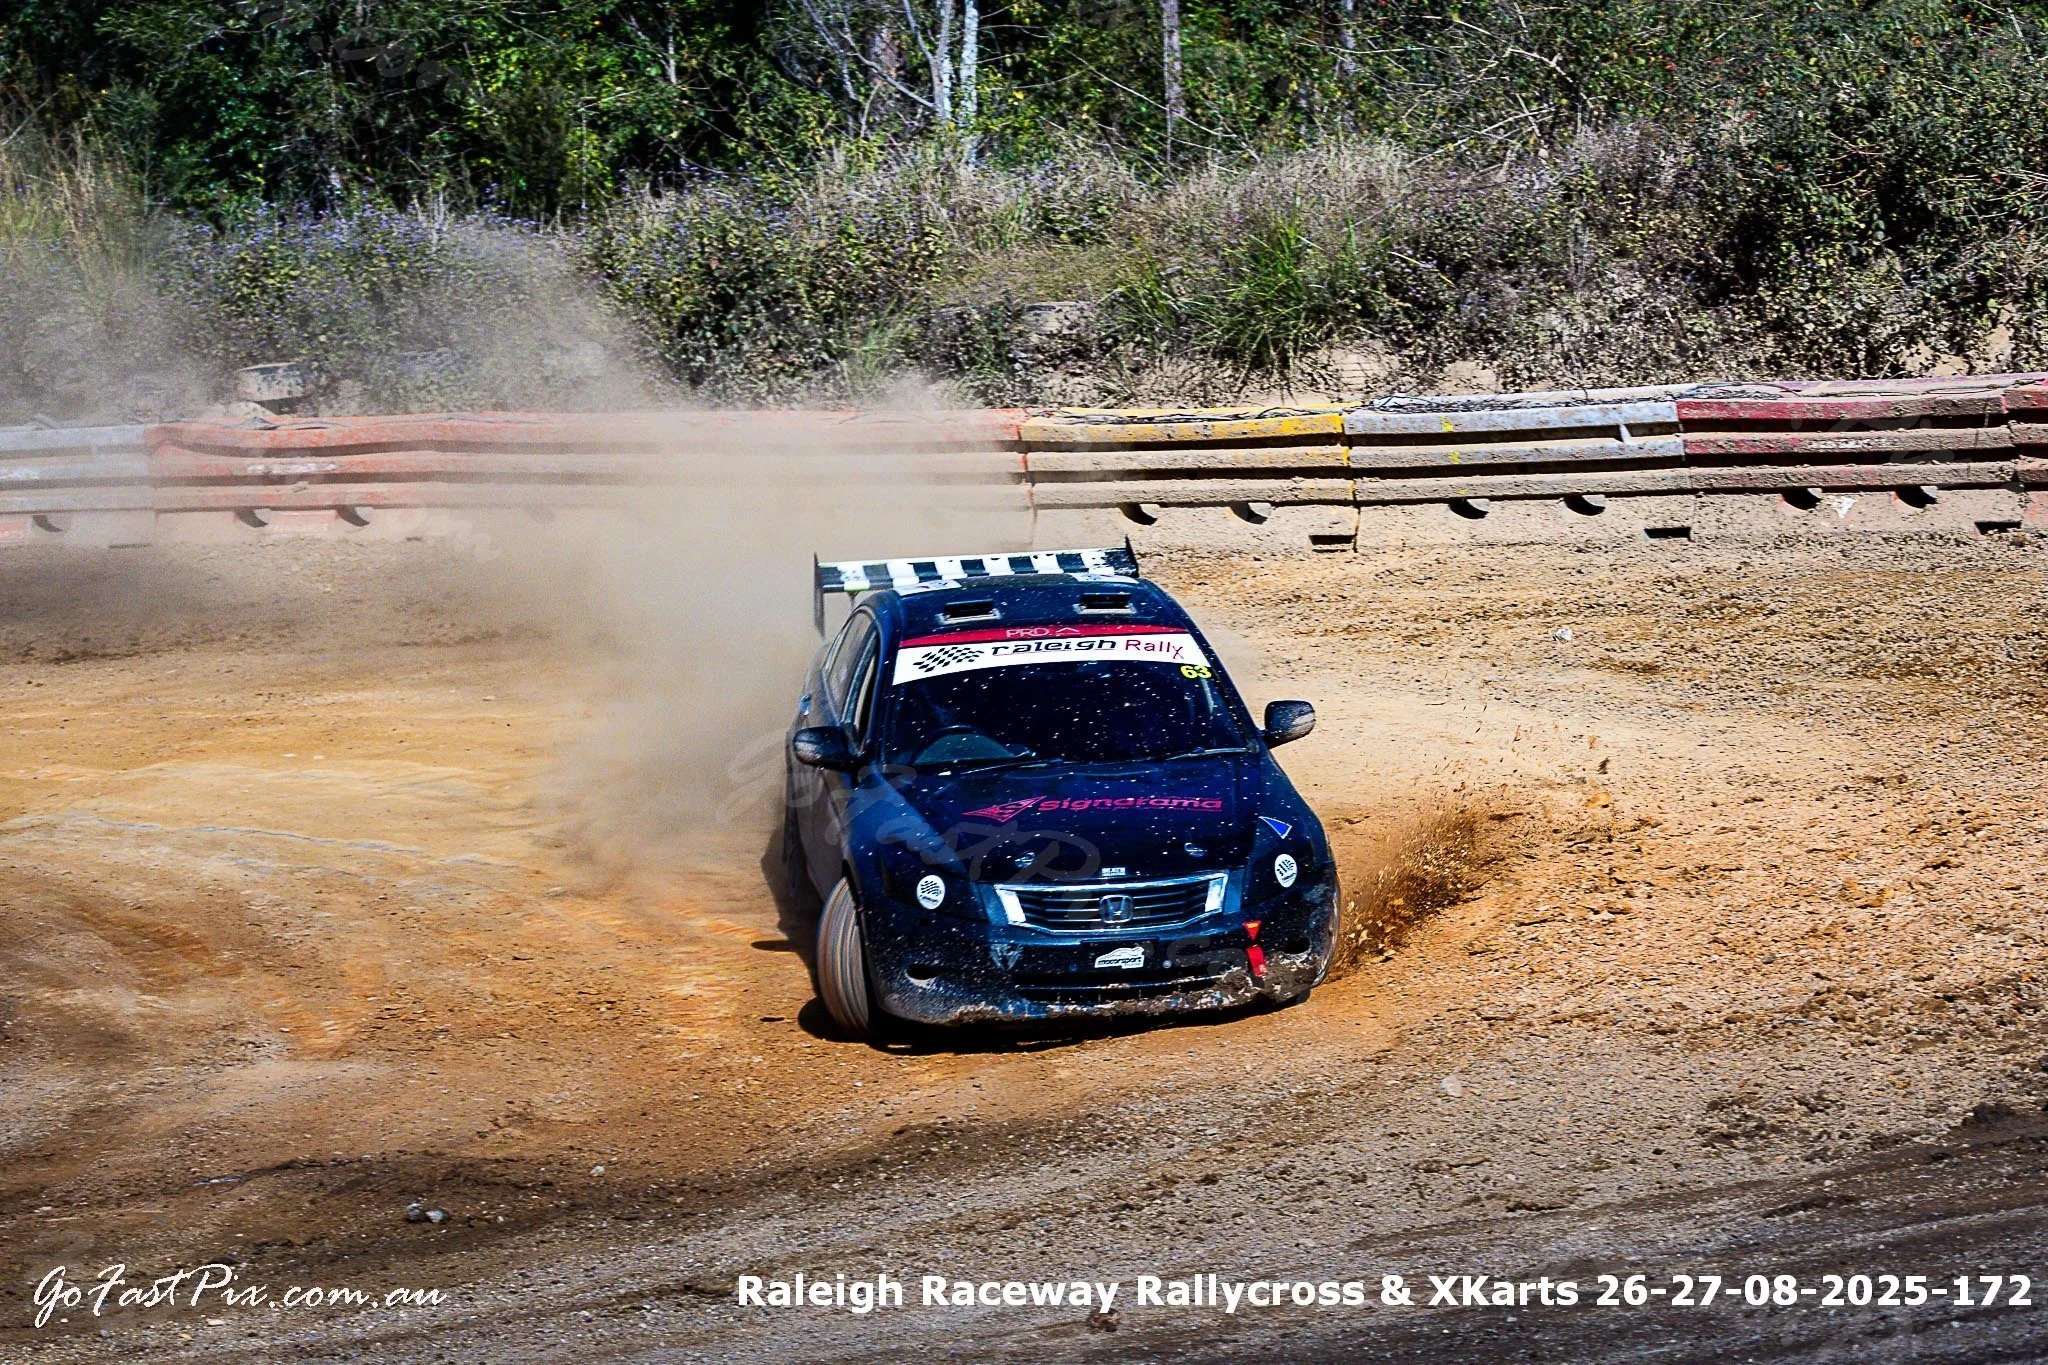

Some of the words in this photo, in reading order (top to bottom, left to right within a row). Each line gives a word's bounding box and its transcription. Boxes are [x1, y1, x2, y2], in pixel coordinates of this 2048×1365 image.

[991, 639, 1117, 656] raleigh
[1180, 665, 1212, 679] 63
[1037, 796, 1223, 812] signarama
